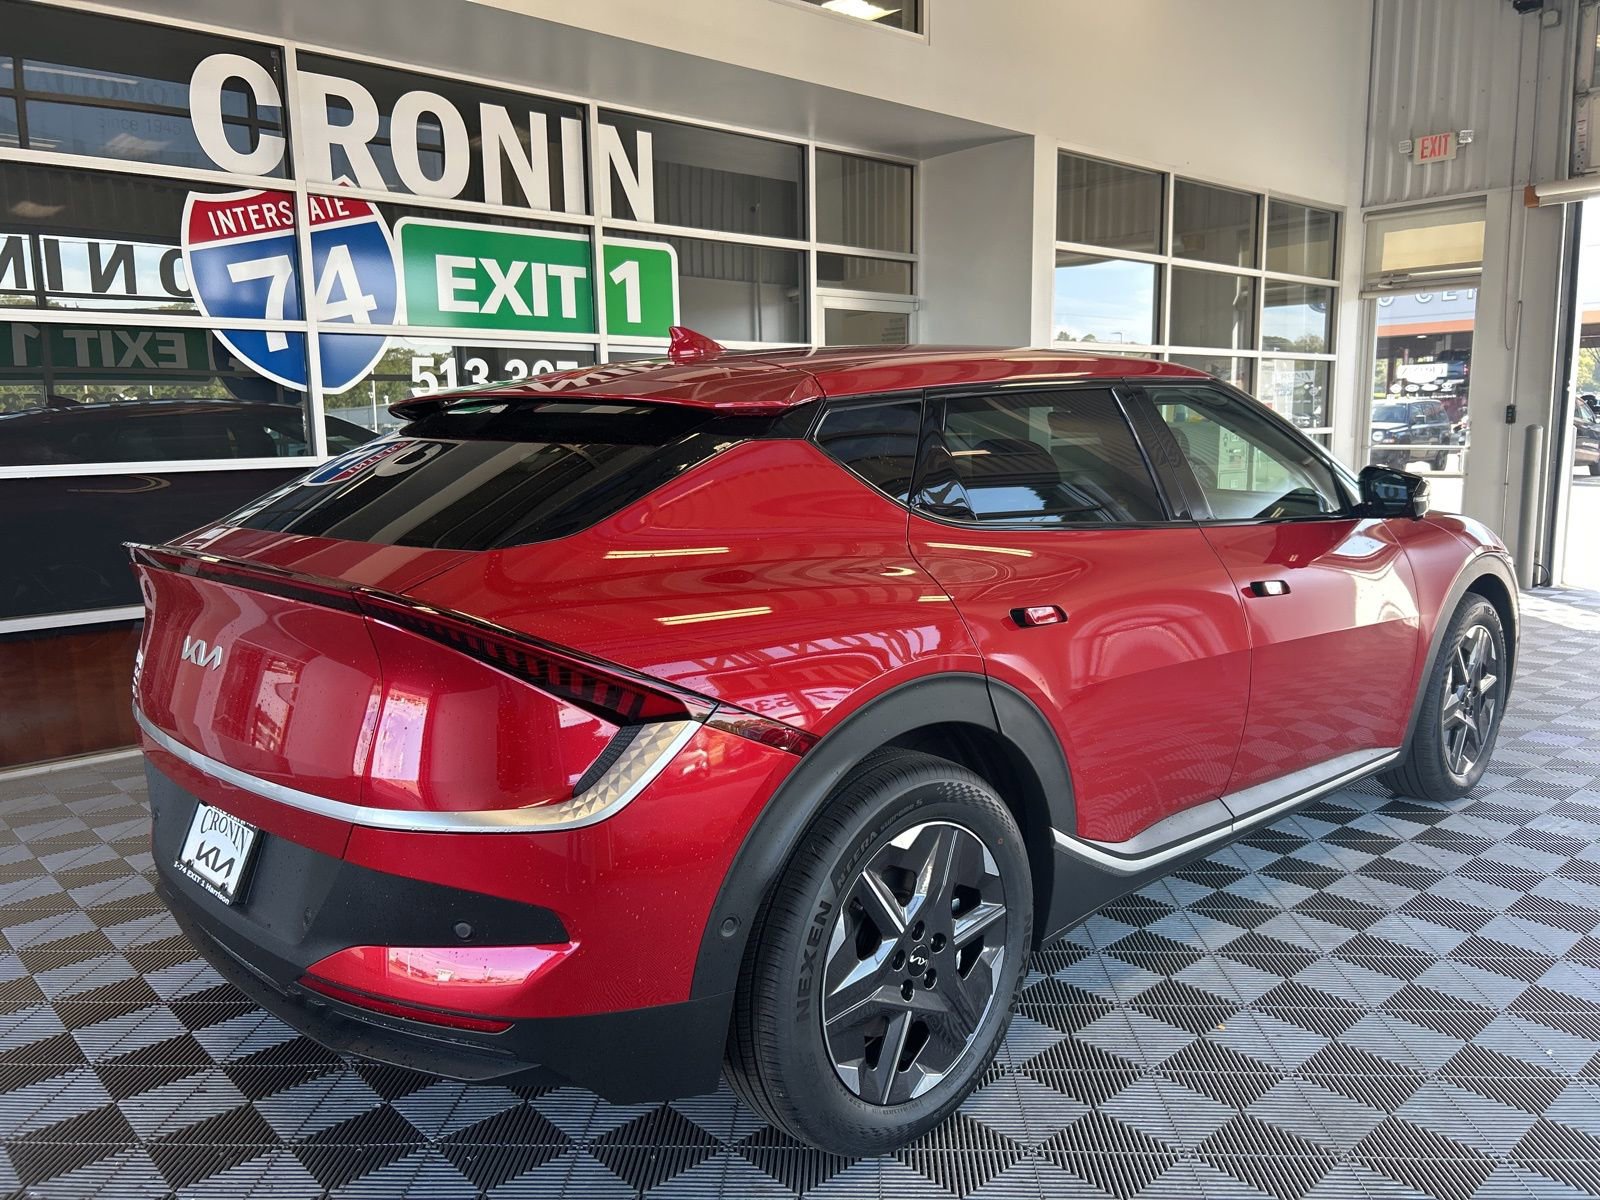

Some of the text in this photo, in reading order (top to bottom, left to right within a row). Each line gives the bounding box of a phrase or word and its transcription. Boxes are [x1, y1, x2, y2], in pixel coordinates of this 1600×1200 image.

[189, 53, 654, 222] CRONIN
[1420, 134, 1450, 159] EXIT
[208, 196, 350, 236] INTERSATE
[226, 244, 378, 353] 74
[435, 254, 642, 324] EXIT 1
[181, 635, 223, 671] KIA
[200, 808, 249, 858] CRONIN
[186, 871, 202, 884] EXIT
[204, 882, 231, 906] Harrison
[796, 900, 833, 1021] NEXEN
